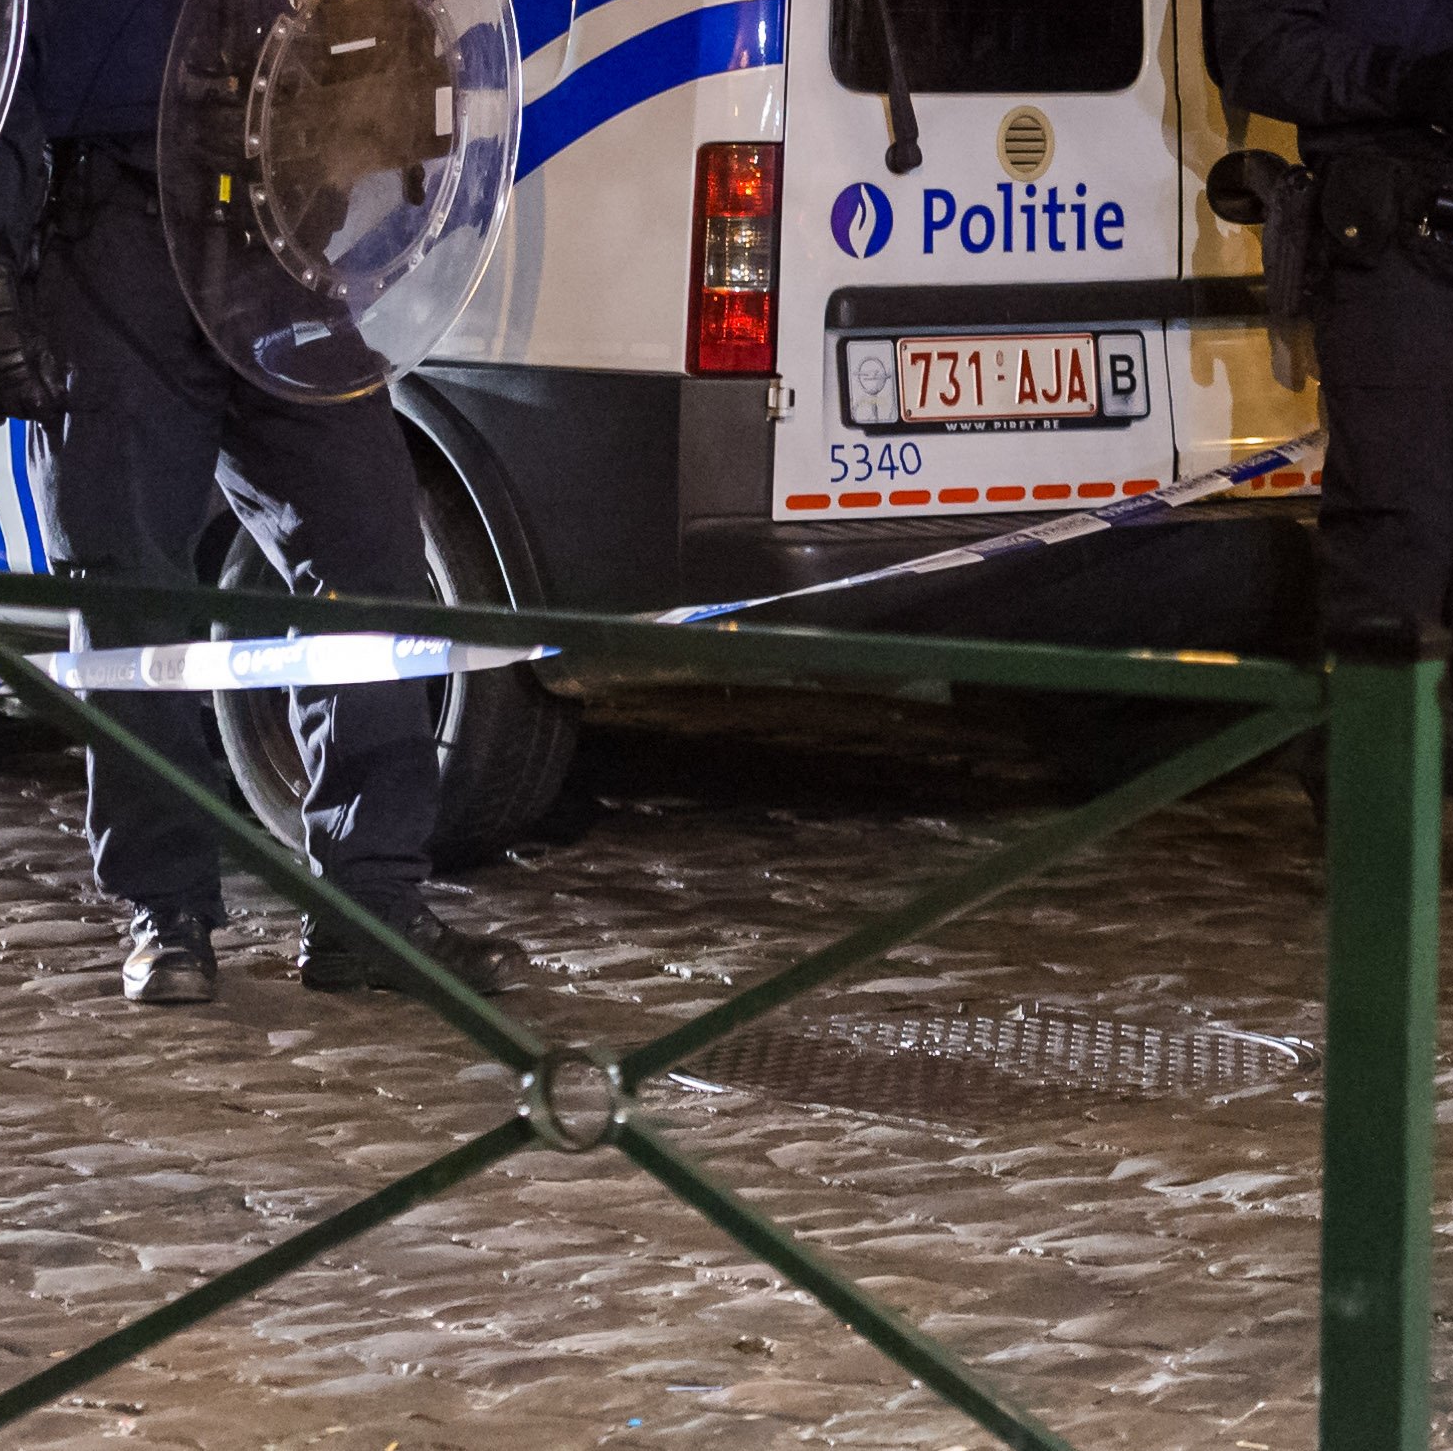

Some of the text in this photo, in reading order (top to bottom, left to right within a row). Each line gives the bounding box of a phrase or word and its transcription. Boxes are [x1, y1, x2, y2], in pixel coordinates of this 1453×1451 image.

[922, 182, 1125, 254] Politie
[1109, 354, 1138, 396] B
[830, 442, 922, 483] 5340
